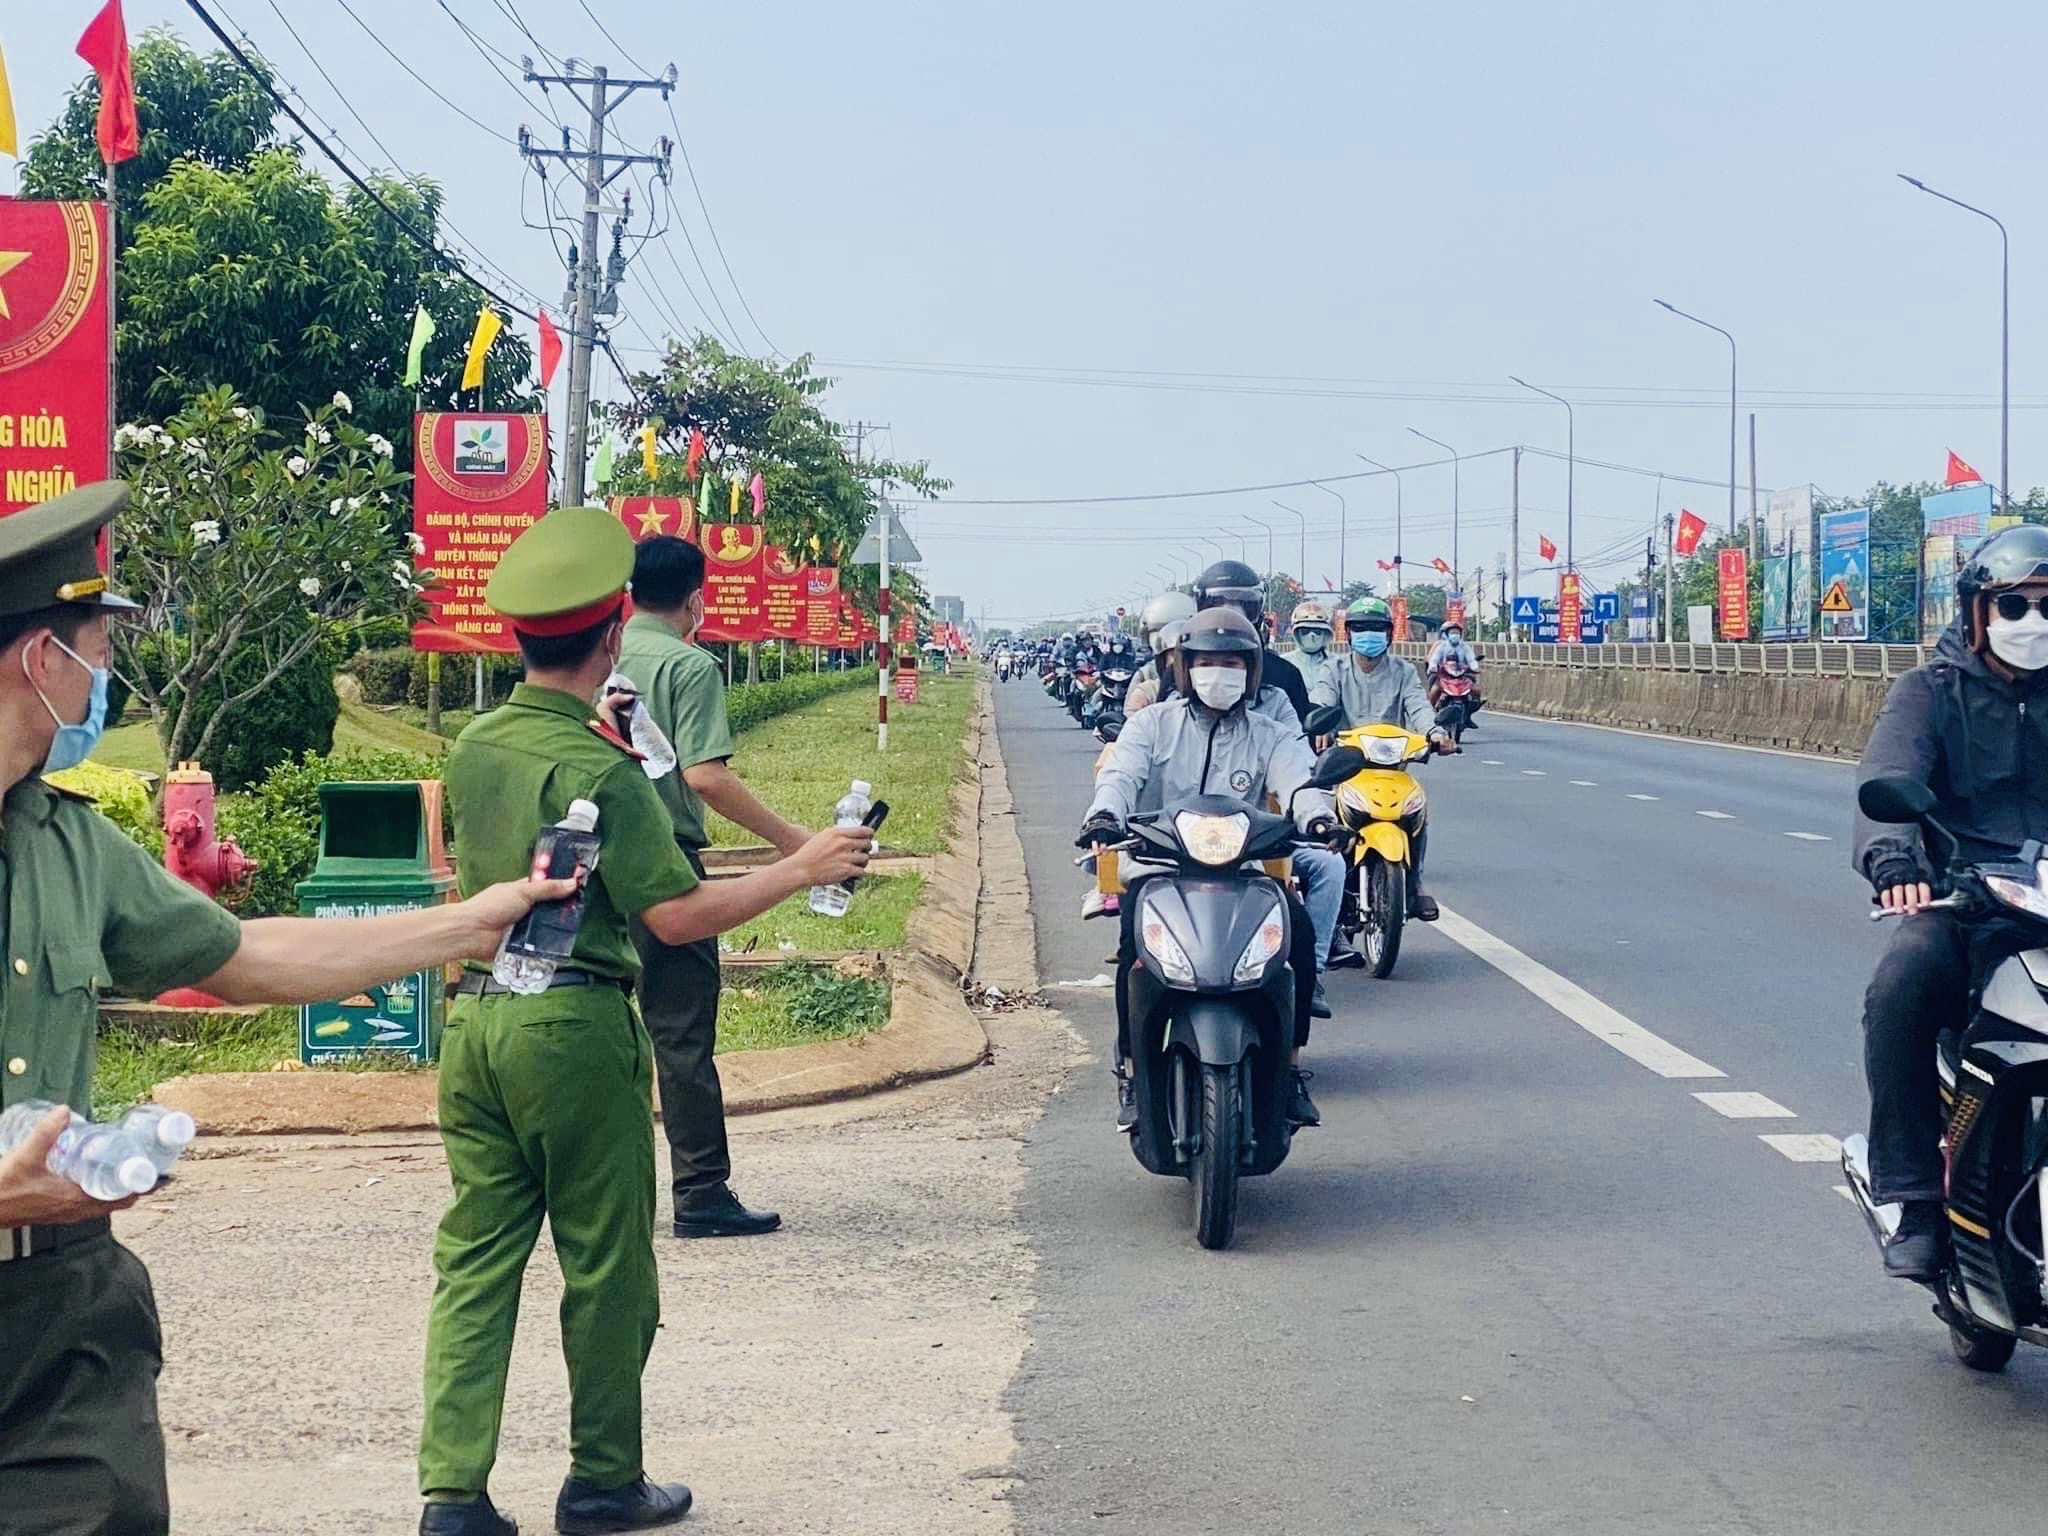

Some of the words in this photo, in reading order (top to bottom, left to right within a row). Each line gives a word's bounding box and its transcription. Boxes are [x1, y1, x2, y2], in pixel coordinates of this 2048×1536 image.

[21, 407, 67, 448] HÒA
[6, 464, 76, 503] NGHĨA
[472, 513, 500, 526] CHÍNH
[448, 530, 461, 544] VÀ
[463, 531, 490, 544] NHÂN
[491, 531, 512, 544] DÂN
[434, 548, 465, 564] HUYỆN
[456, 584, 475, 597] XÂY
[442, 601, 469, 615] NÔNG
[455, 620, 481, 634] NÂNG
[483, 622, 502, 634] CAO
[315, 902, 355, 919] PHÒNG
[376, 901, 423, 917] NGUYÊ
